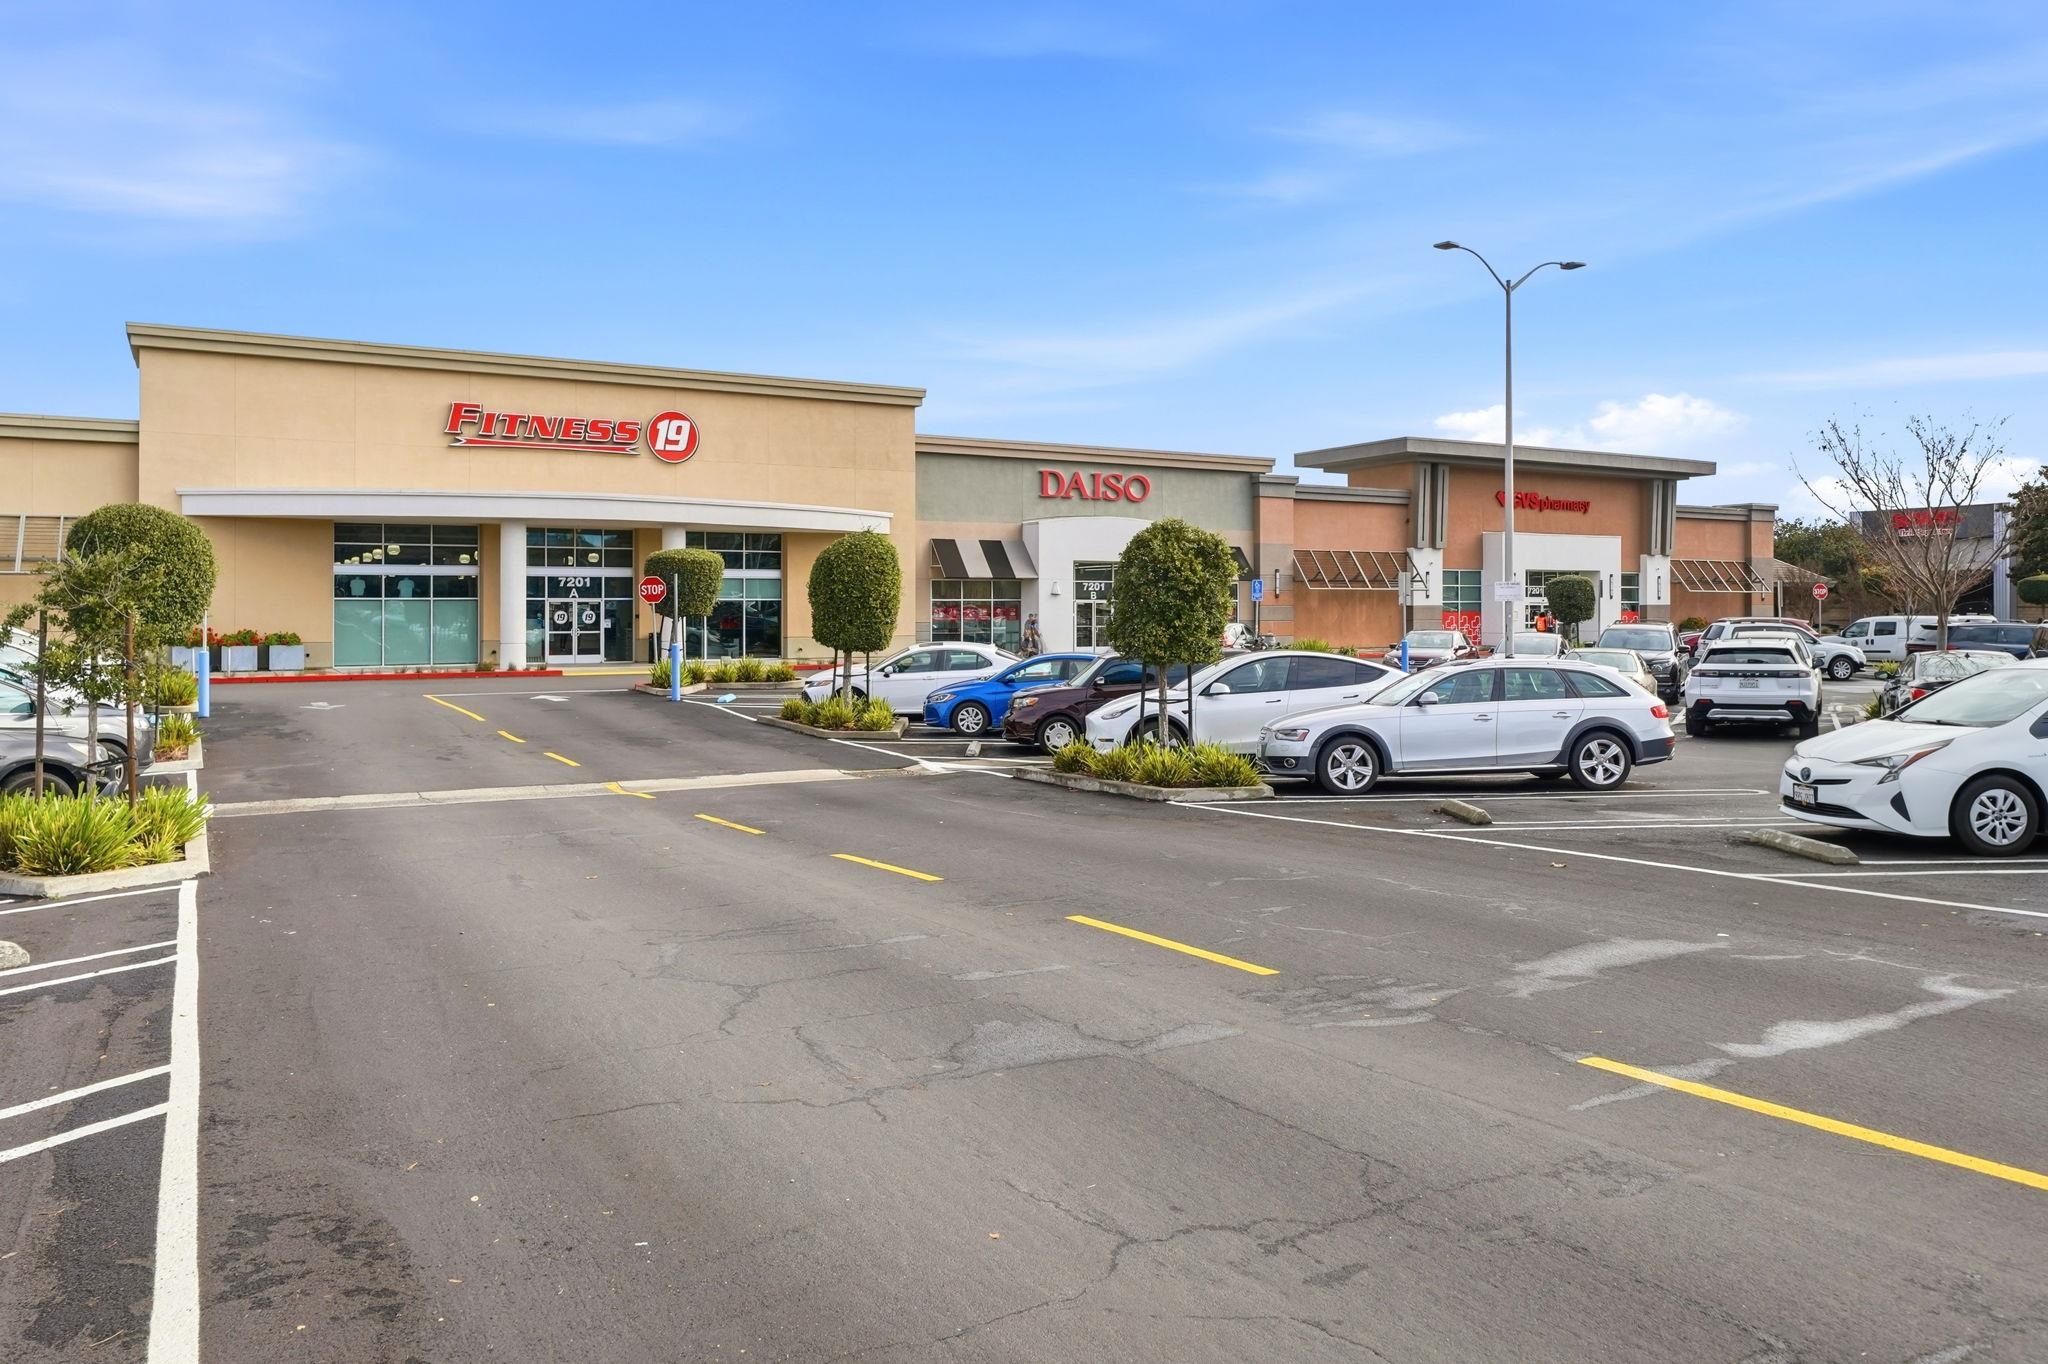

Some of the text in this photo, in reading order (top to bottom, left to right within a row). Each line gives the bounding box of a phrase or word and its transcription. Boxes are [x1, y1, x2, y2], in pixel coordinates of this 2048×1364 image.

[444, 401, 691, 451] FITNESS 19
[1038, 469, 1151, 503] DAISO
[1539, 496, 1591, 514] pharmacy
[558, 577, 591, 587] 7201
[1082, 582, 1105, 591] 7201
[569, 588, 579, 598] A
[640, 584, 664, 596] STOP
[1090, 591, 1097, 600] B
[557, 613, 566, 622] 19
[585, 613, 594, 622] 19
